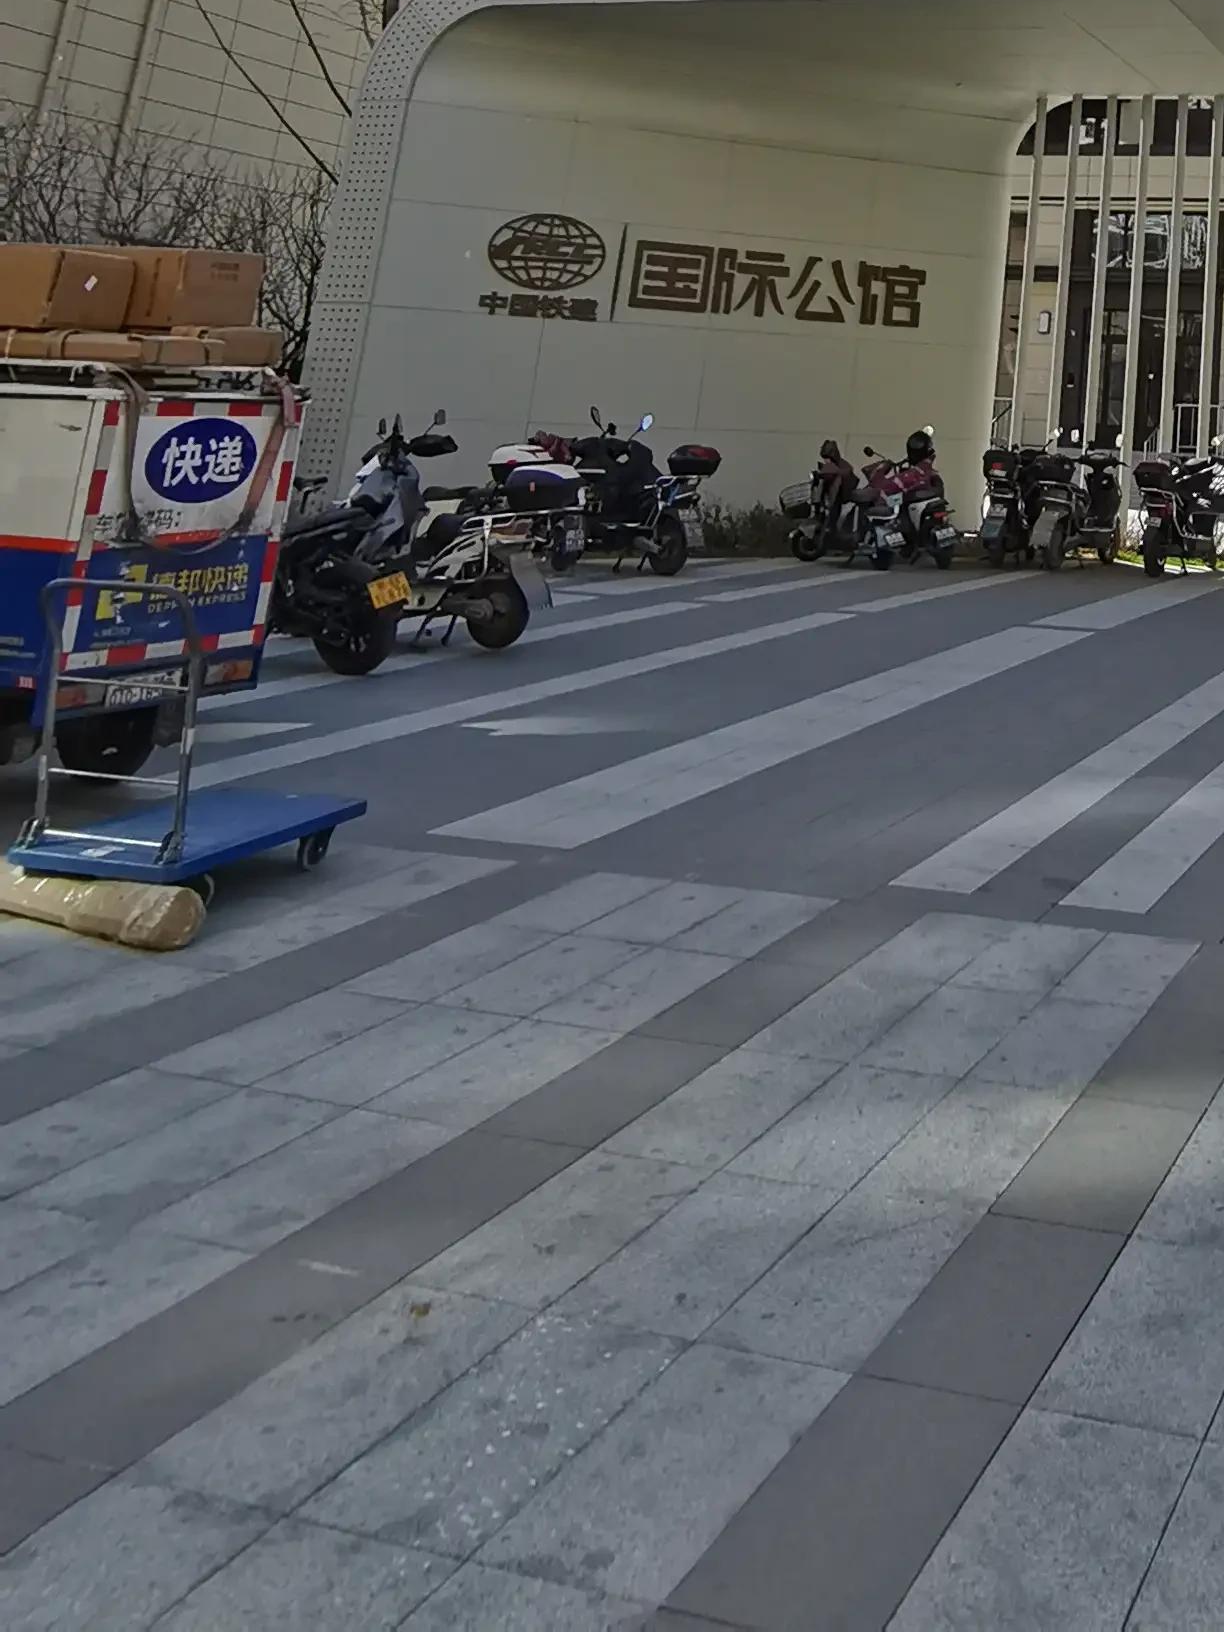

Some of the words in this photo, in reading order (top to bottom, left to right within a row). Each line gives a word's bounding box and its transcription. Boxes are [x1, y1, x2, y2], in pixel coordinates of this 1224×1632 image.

[628, 240, 926, 328] 国际公馆
[161, 435, 244, 488] 快递
